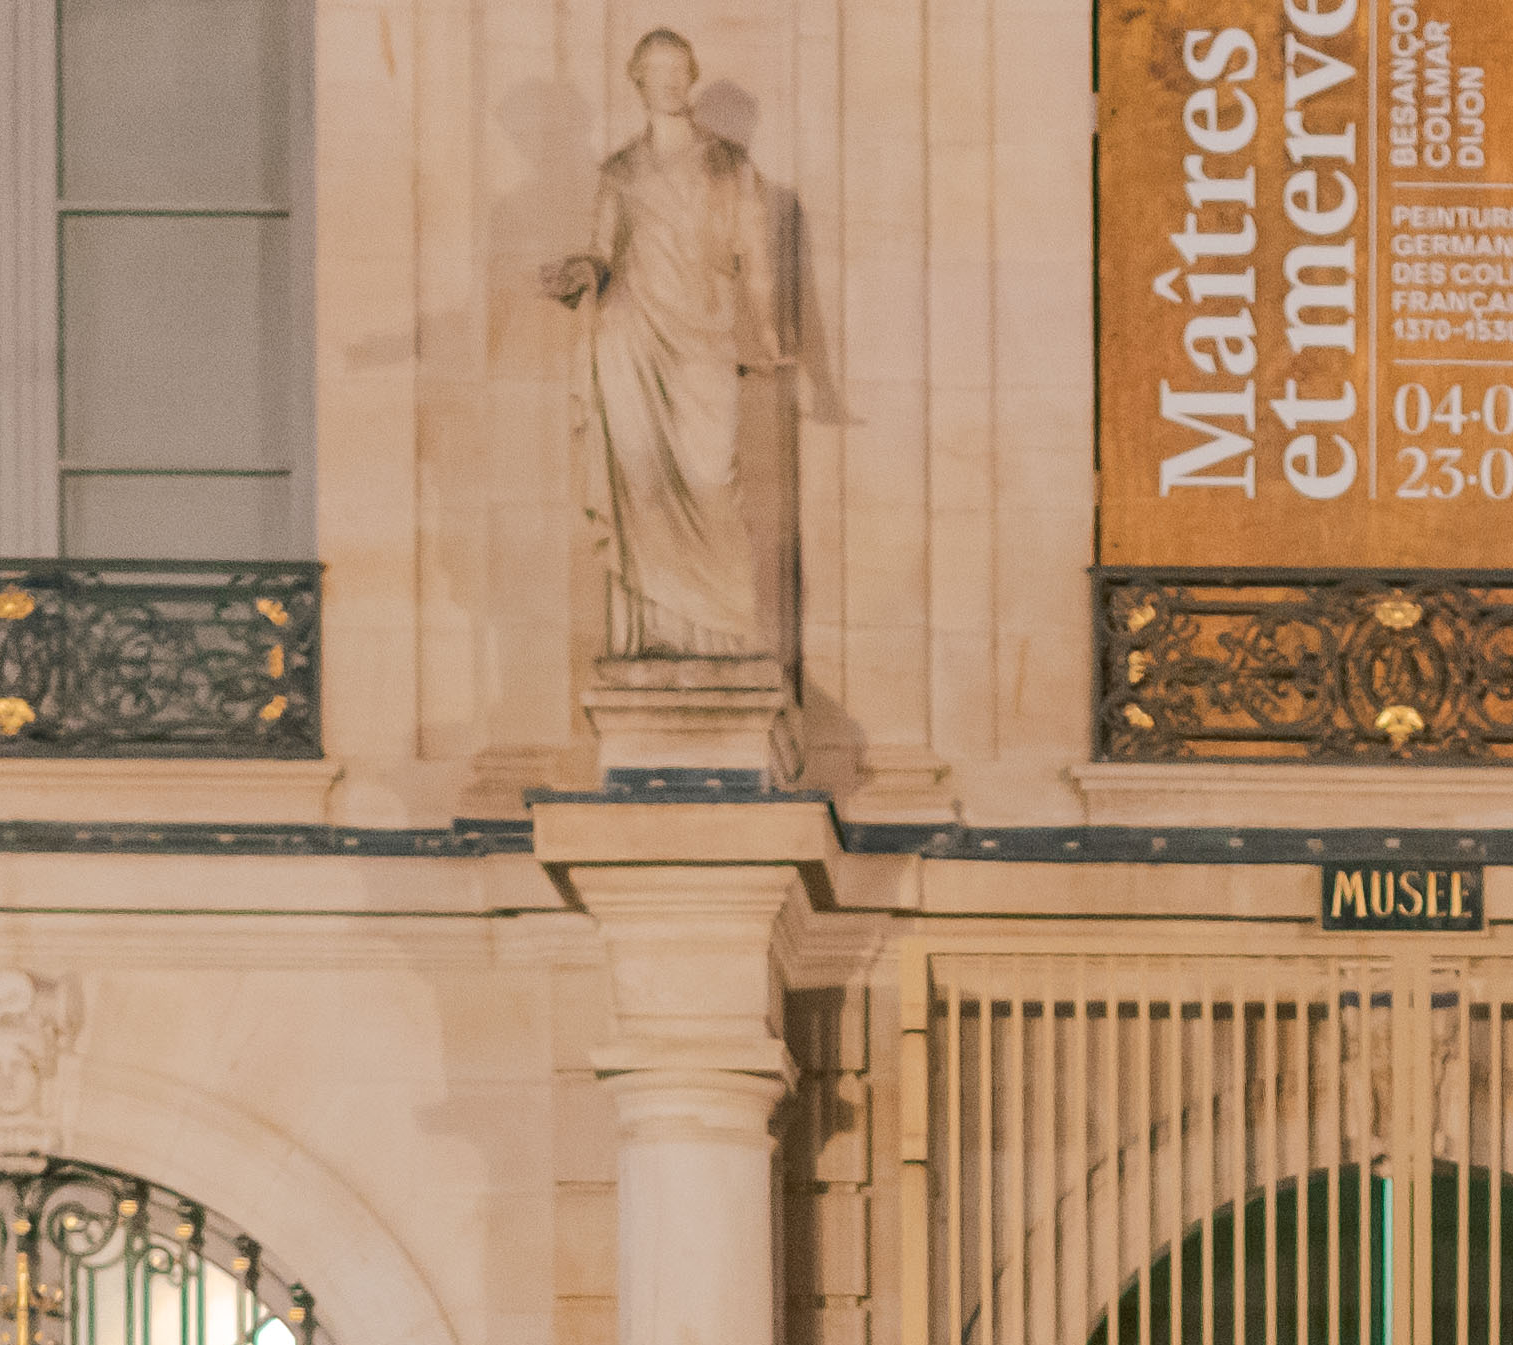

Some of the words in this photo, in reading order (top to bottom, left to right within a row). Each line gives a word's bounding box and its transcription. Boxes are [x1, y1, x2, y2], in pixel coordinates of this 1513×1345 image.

[1389, 0, 1425, 168] BESANÇO
[1423, 20, 1451, 169] COLMAR
[1457, 66, 1485, 168] DIJON
[1153, 27, 1257, 500] Maîtres
[1391, 262, 1447, 286] DES
[1270, 378, 1358, 500] et
